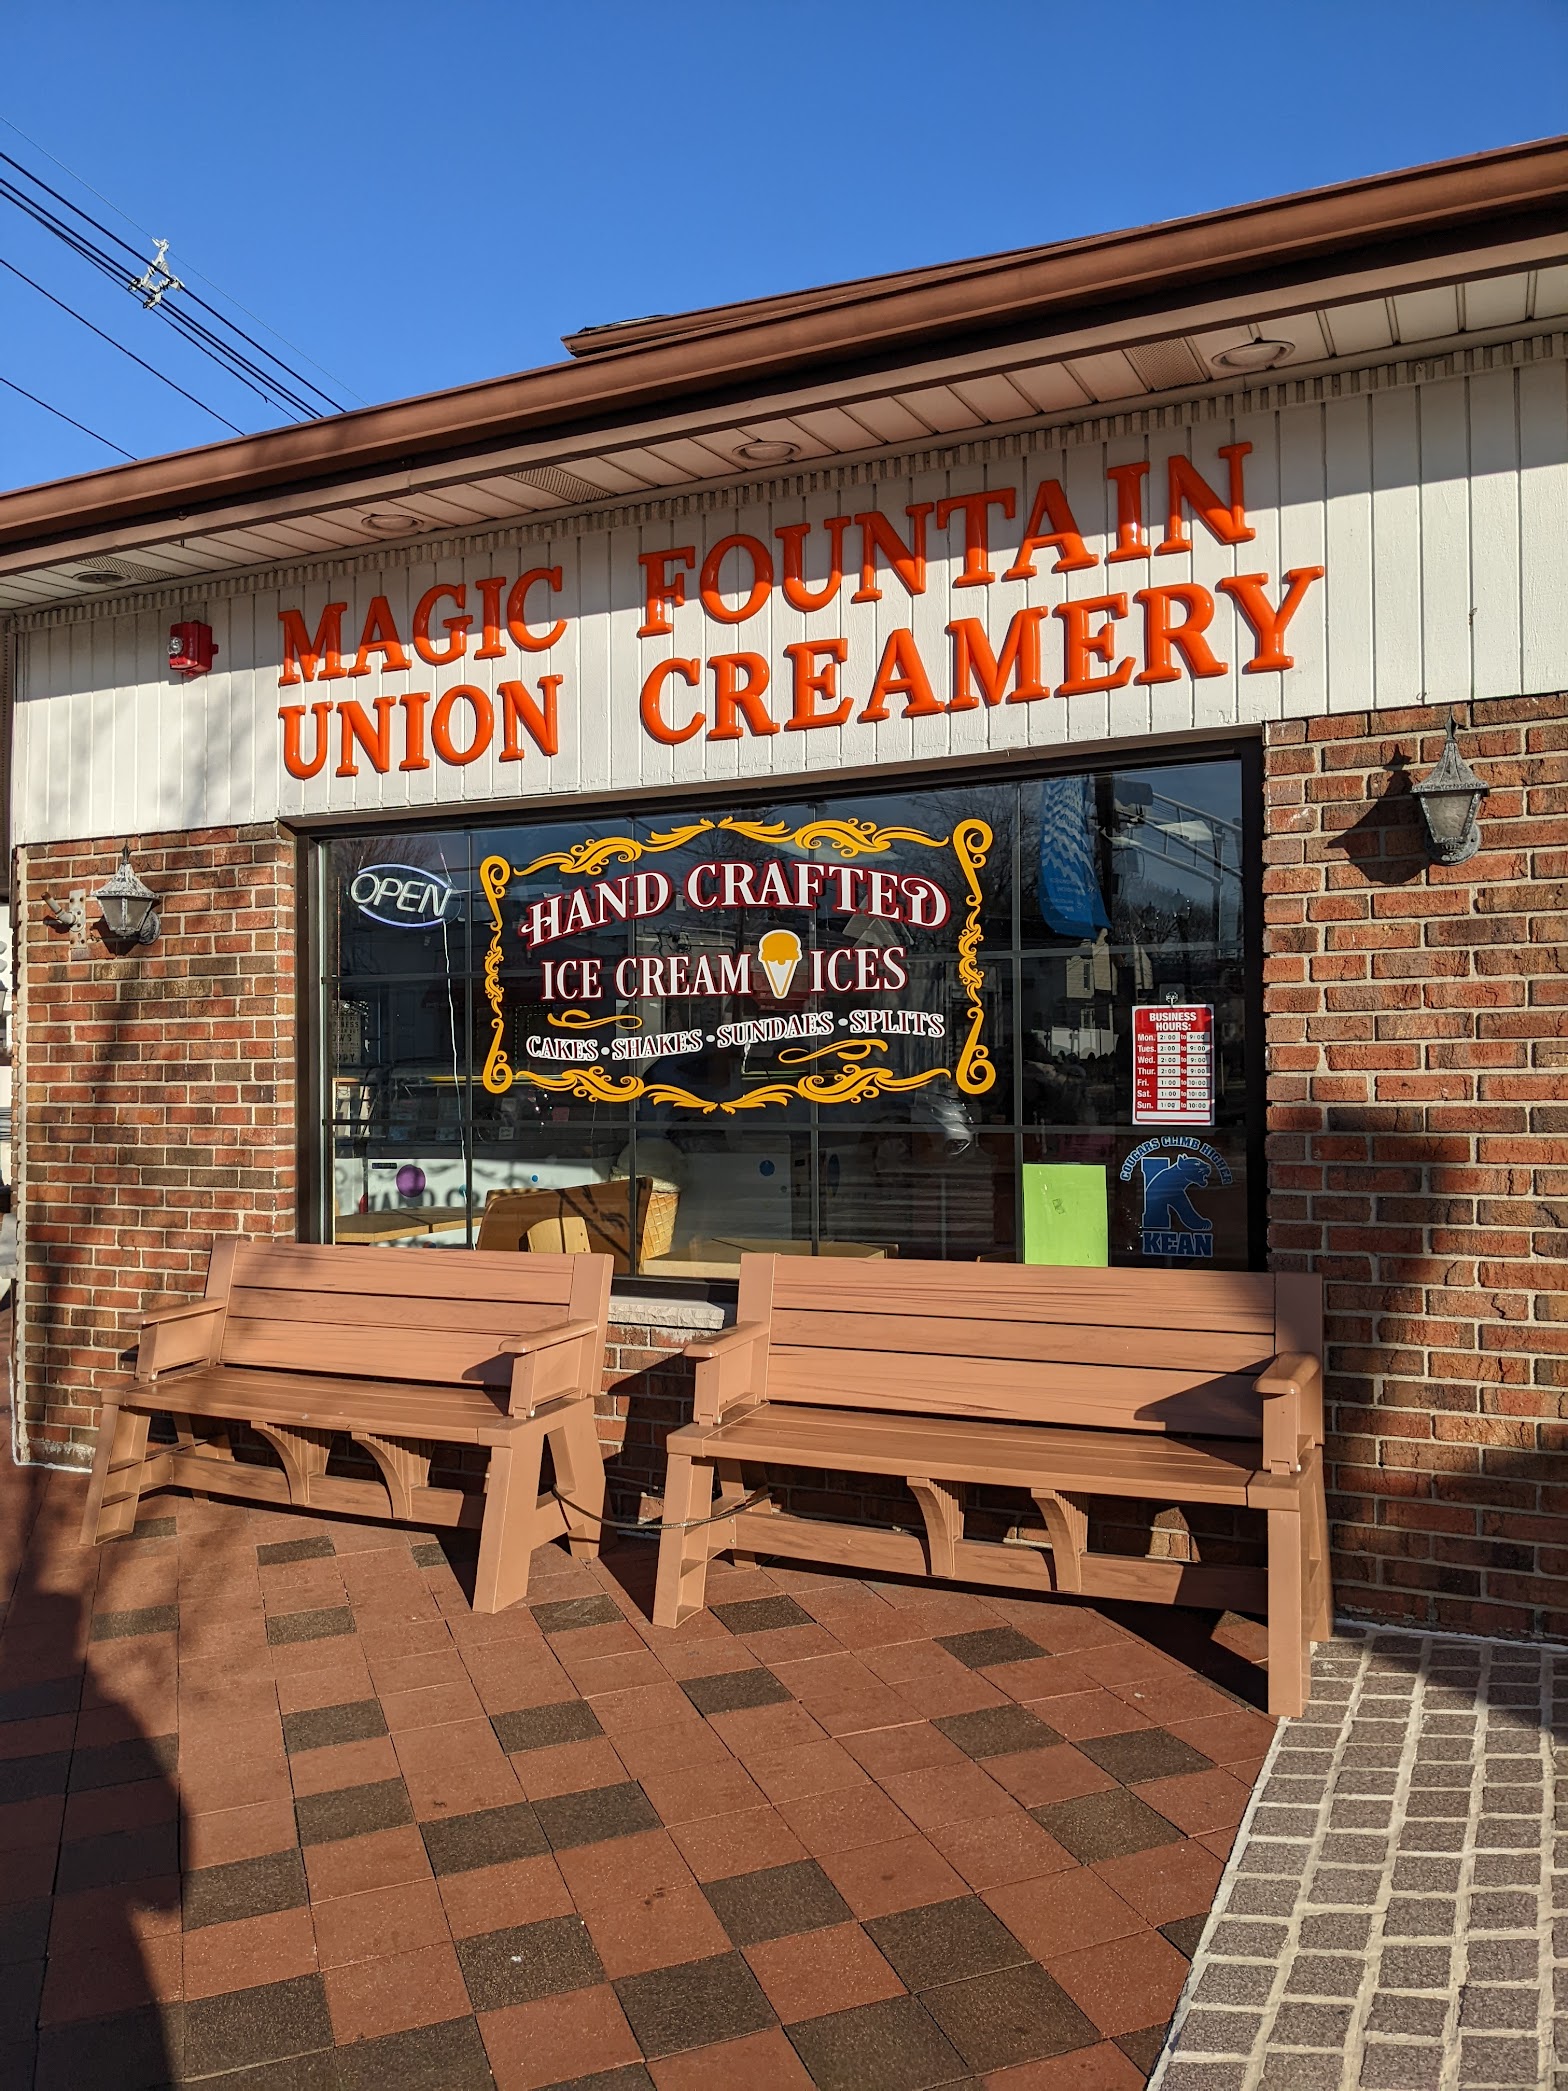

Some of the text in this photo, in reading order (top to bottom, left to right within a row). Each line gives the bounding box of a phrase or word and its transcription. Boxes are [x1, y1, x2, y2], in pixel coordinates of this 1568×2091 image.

[278, 441, 1256, 686] MAGIC FOUNTAIN
[278, 565, 1325, 779] UNION CREAMERY
[351, 873, 452, 917] OPEN
[519, 860, 950, 949] HAND CRAFTED
[541, 945, 908, 1000] ICE CREAM ICES
[1149, 1012, 1197, 1022] BUSINESS
[1155, 1021, 1192, 1031] HOURS:
[526, 1009, 946, 1062] CAKES SHAKES SUNDAES SPLITS
[1137, 1033, 1156, 1042] Mon.
[1137, 1045, 1157, 1053] Tues.
[1137, 1056, 1156, 1064] Wed.
[1137, 1067, 1156, 1075] Thur.
[1137, 1078, 1150, 1087] Fri.
[1137, 1090, 1152, 1098] Sat.
[1137, 1101, 1154, 1109] Sun.
[1120, 1135, 1233, 1185] COUGARS CLIMB HIGHER
[1142, 1231, 1214, 1258] KEAN
